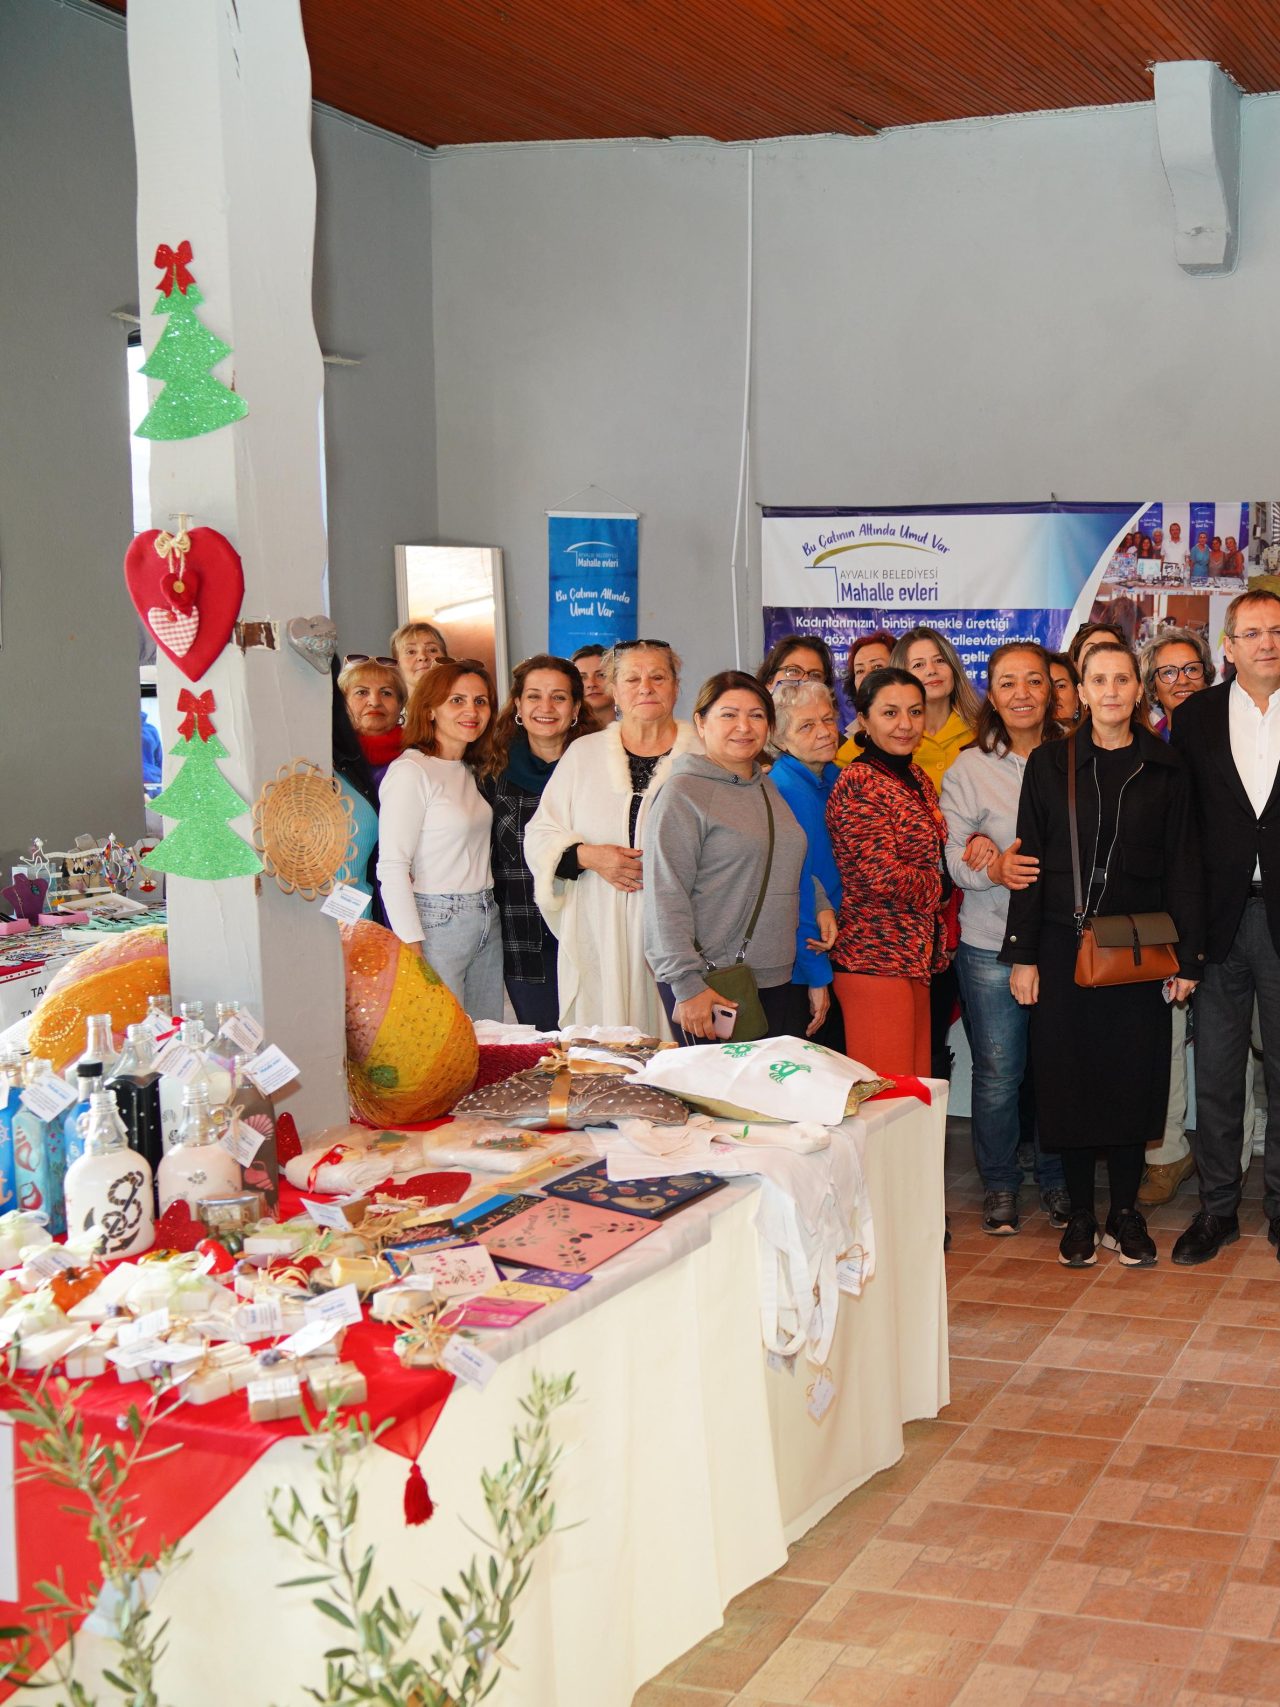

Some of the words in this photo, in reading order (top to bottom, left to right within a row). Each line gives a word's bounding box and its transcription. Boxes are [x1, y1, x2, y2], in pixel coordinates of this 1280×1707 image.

[802, 542, 817, 556] Bu
[818, 528, 855, 550] Çatının
[859, 523, 896, 537] Altında
[900, 524, 928, 545] Umut
[932, 534, 950, 554] Var
[840, 569, 880, 579] AYVALIK
[882, 566, 939, 579] BELEDİYESİ
[556, 589, 567, 602] Bu
[569, 587, 598, 602] Çatının
[600, 588, 630, 604] Altında
[841, 582, 894, 601] Mahalle
[899, 582, 938, 601] evleri
[569, 602, 594, 617] Umut
[597, 601, 614, 618] Var
[796, 616, 879, 630] Kadınlarımızın,
[882, 617, 916, 629] binbir
[918, 618, 963, 629] emekle
[966, 617, 1009, 632] ürettiği
[824, 633, 845, 646] göz
